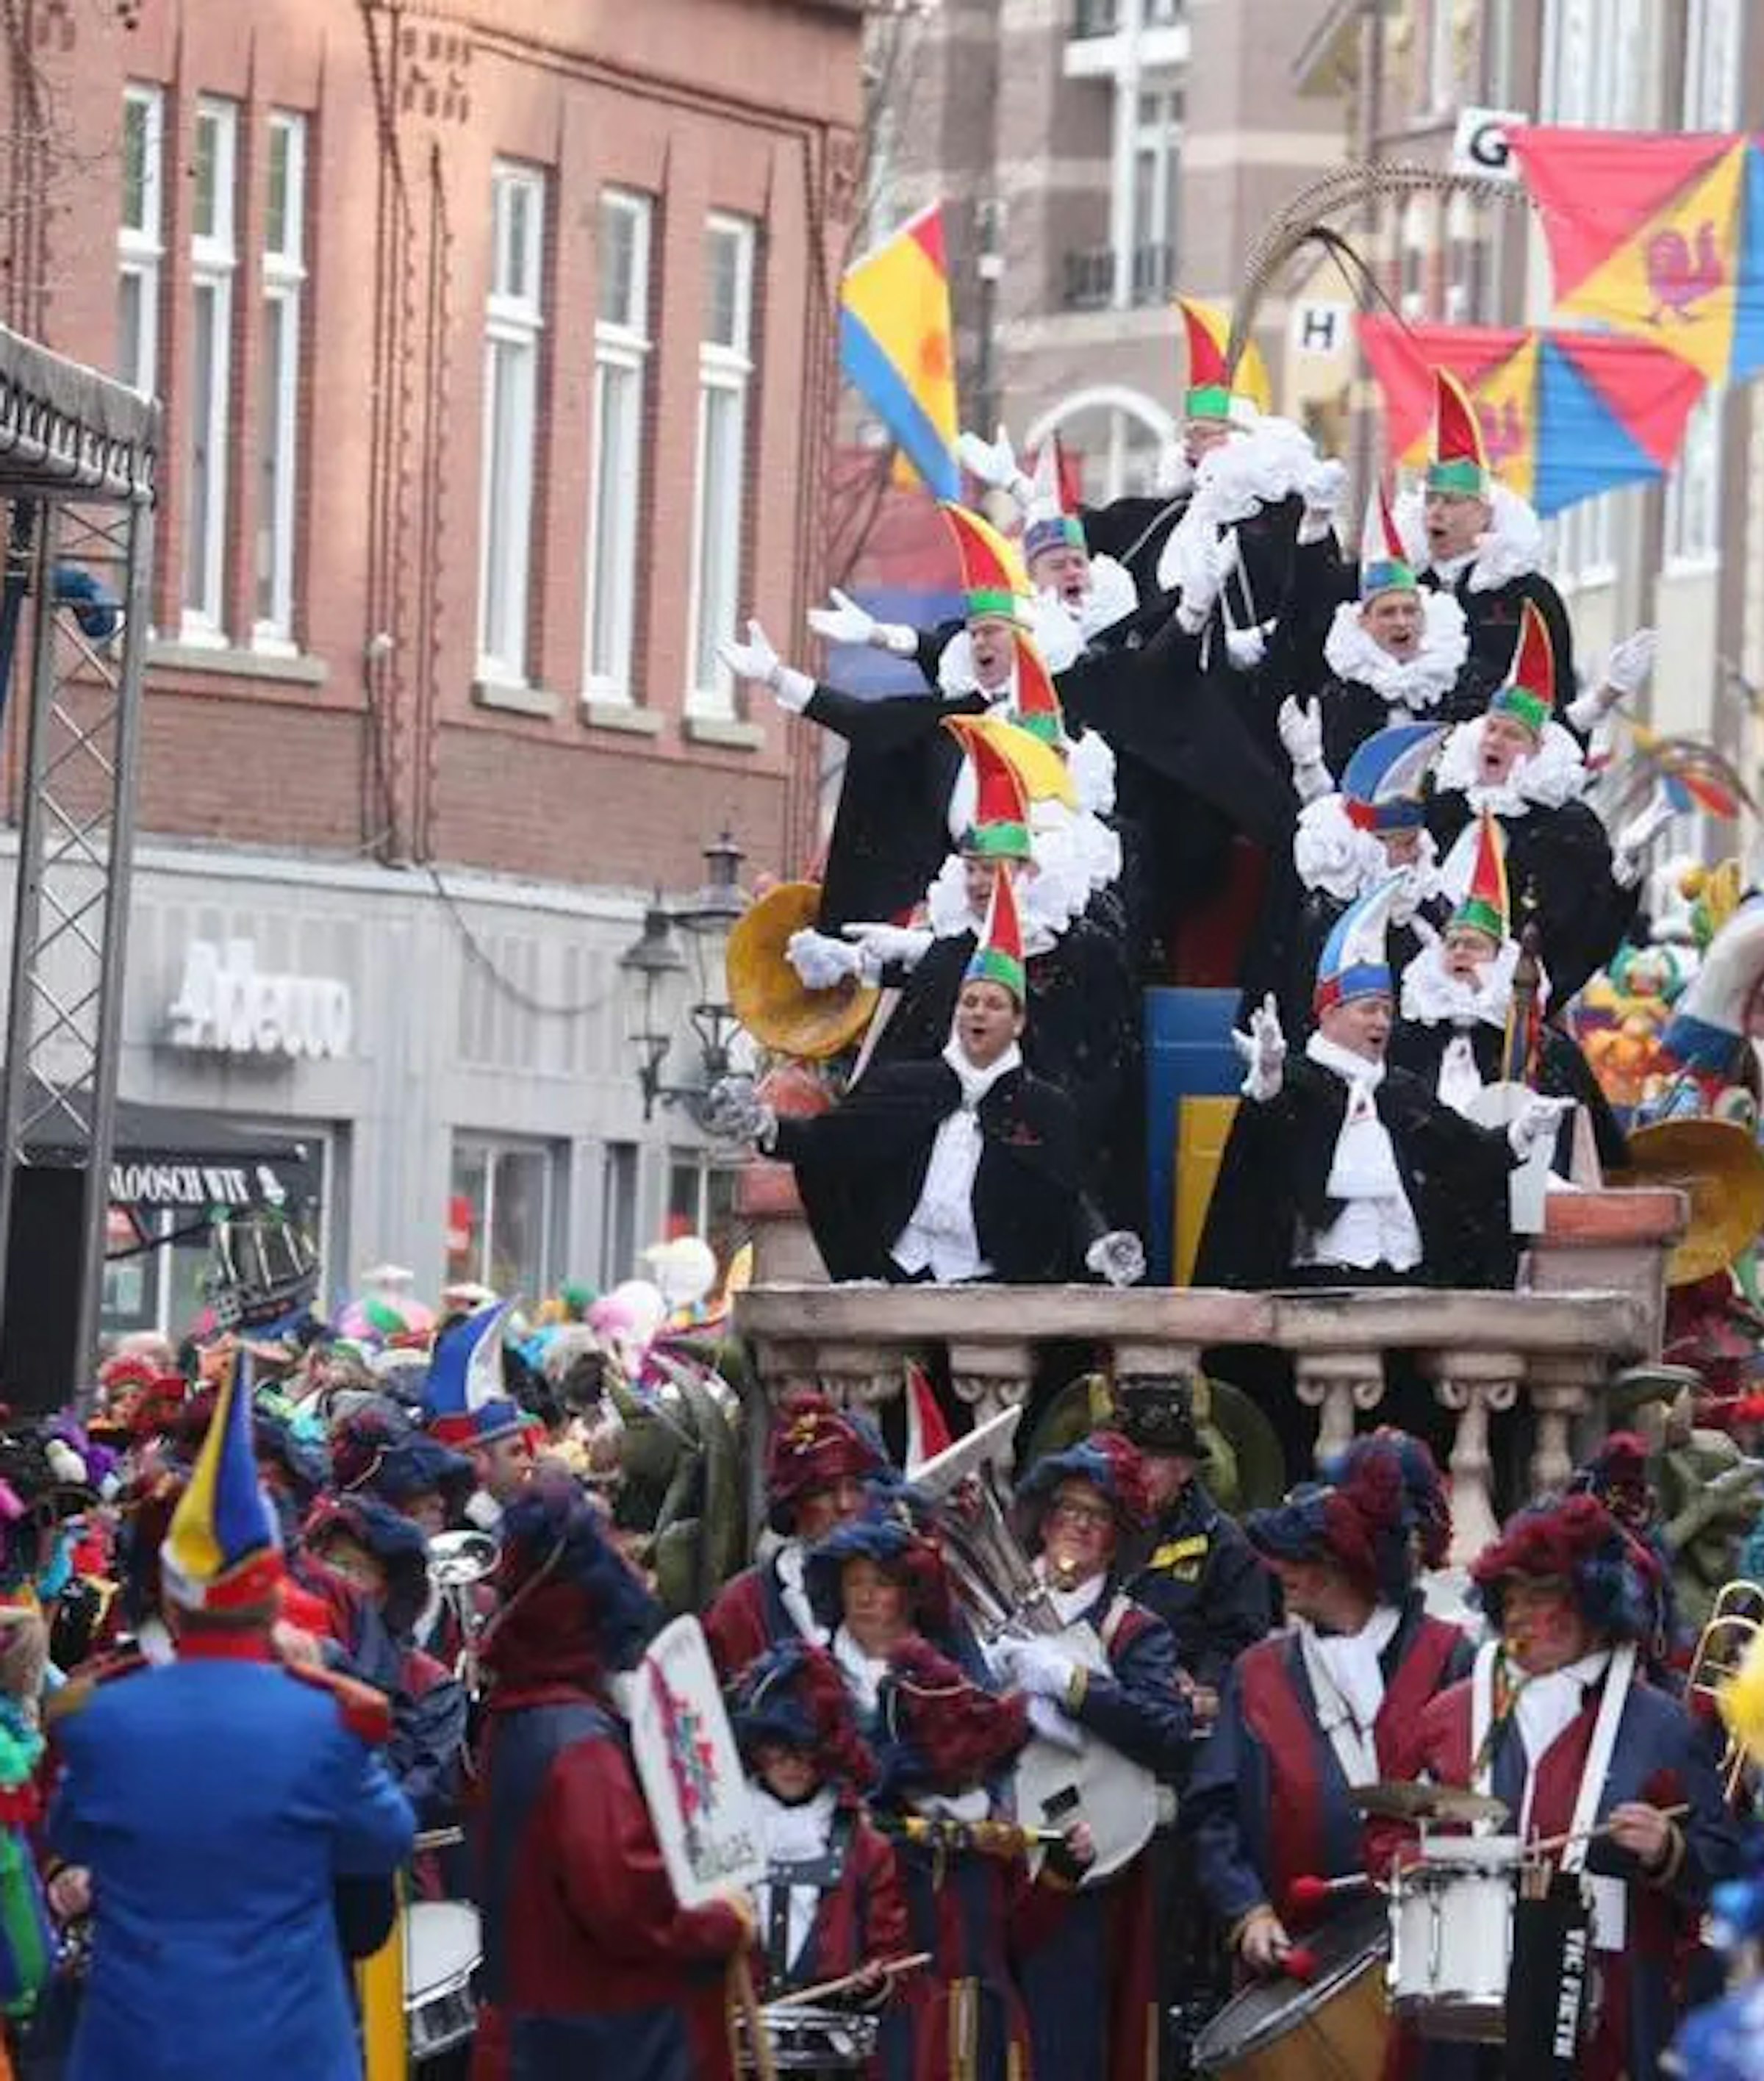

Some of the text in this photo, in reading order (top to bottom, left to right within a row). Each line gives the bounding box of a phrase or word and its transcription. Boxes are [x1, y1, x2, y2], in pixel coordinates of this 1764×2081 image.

[1469, 123, 1510, 168] G
[1302, 309, 1335, 350] H
[1563, 1930, 1586, 1973] VIC
